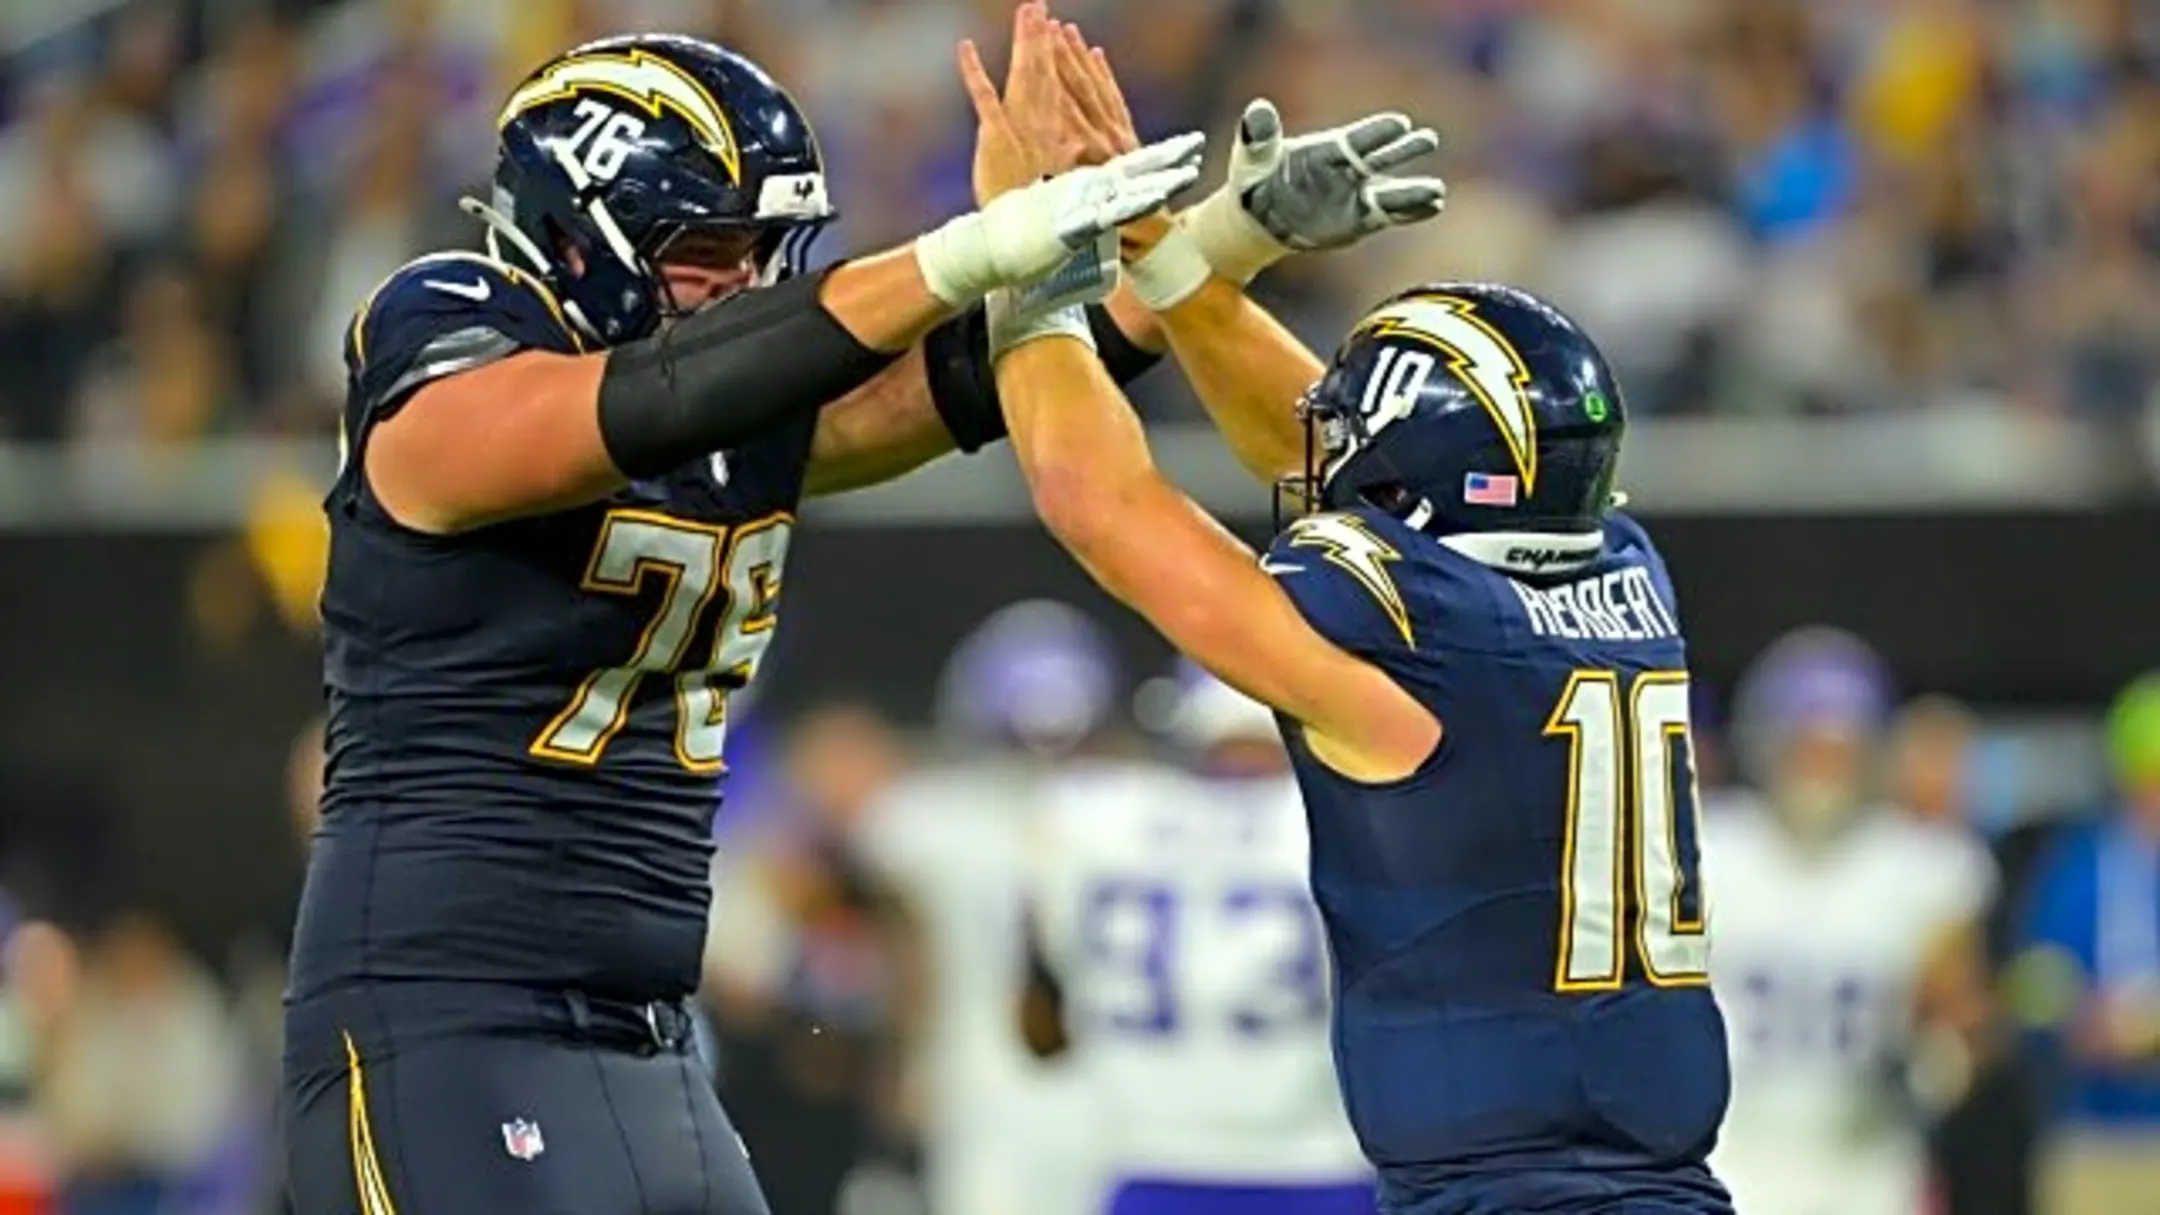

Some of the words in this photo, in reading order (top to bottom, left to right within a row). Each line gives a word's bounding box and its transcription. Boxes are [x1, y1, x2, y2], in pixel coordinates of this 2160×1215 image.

[572, 97, 646, 181] 76
[1359, 346, 1436, 420] 10
[529, 508, 796, 775] 76
[1507, 566, 1678, 639] HERBERT
[1543, 669, 1711, 992] 10
